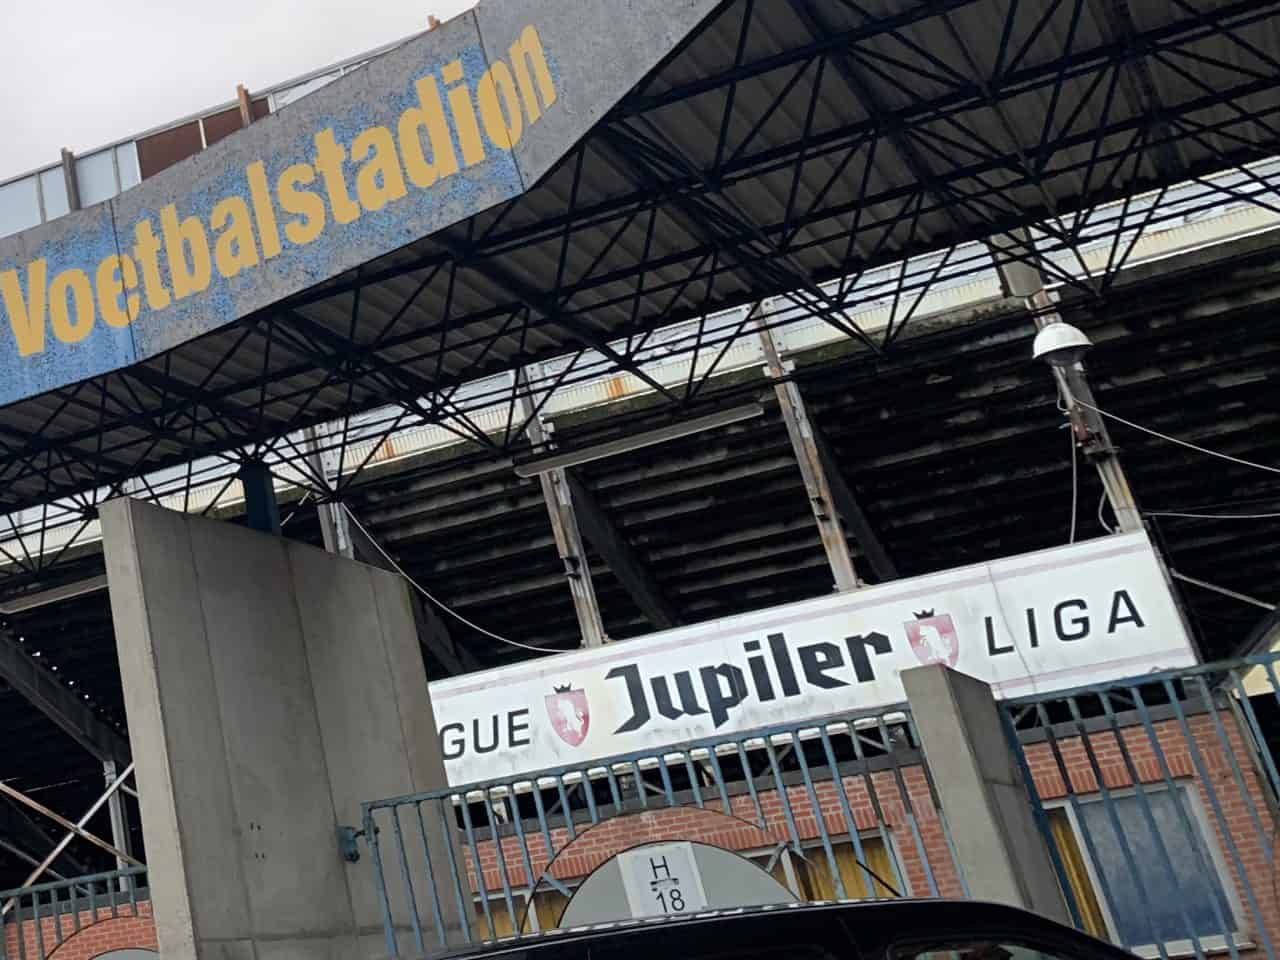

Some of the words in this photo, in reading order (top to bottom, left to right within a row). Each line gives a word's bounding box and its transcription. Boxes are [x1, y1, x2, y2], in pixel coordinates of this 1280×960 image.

[440, 708, 530, 761] GUE
[605, 632, 893, 735] Jupiler
[984, 589, 1145, 656] LIGA
[649, 855, 671, 880] H
[655, 889, 686, 914] 18
